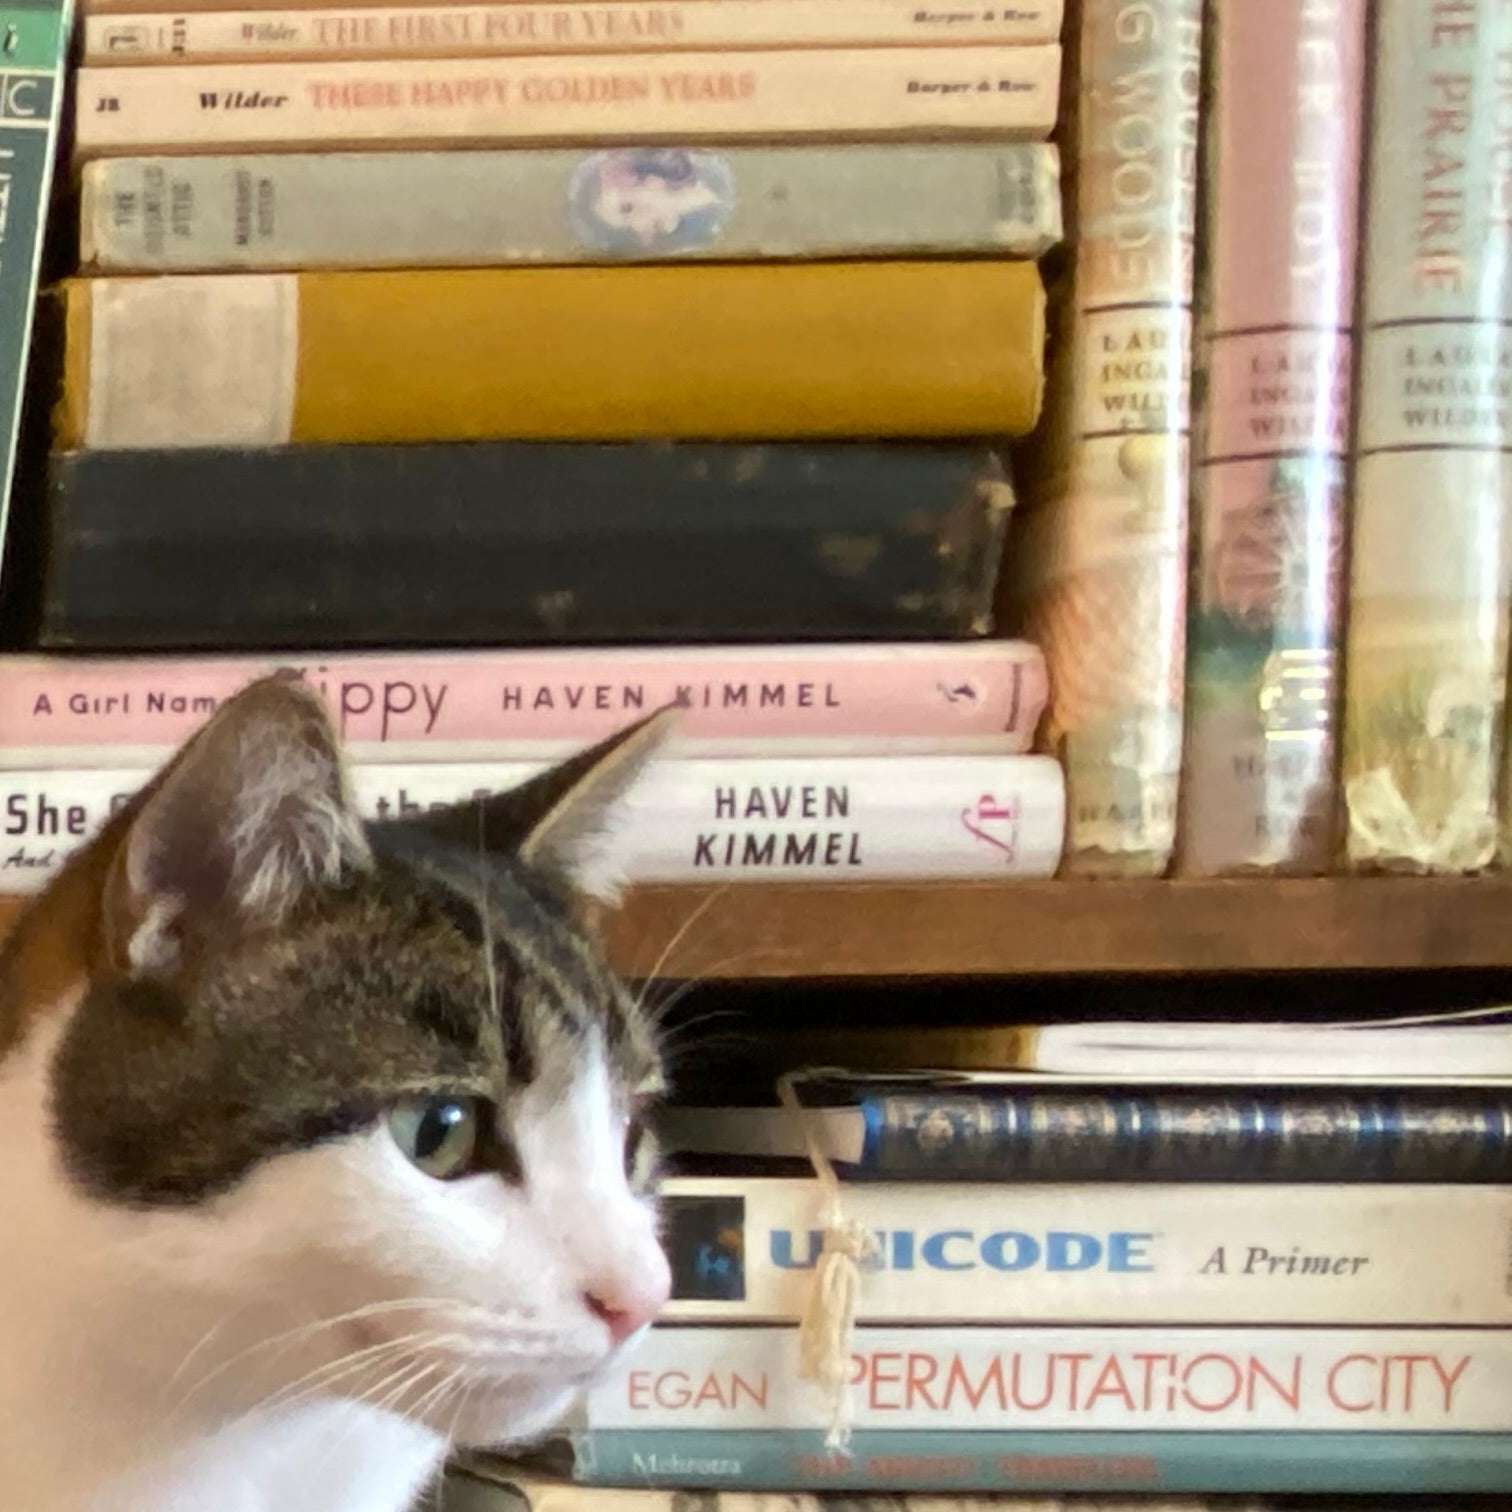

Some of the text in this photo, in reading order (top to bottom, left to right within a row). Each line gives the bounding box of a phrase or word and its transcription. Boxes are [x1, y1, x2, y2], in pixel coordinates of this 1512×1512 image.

[199, 90, 290, 112] Wilder
[32, 682, 843, 716] A Girl HAVEN KIMMEL
[4, 792, 88, 837] She
[714, 785, 851, 819] HAVEN
[693, 833, 864, 867] KIMMEL
[768, 1229, 1370, 1277] UICODE A Primer
[627, 1370, 769, 1412] EGAN
[1326, 1352, 1472, 1414] CITY
